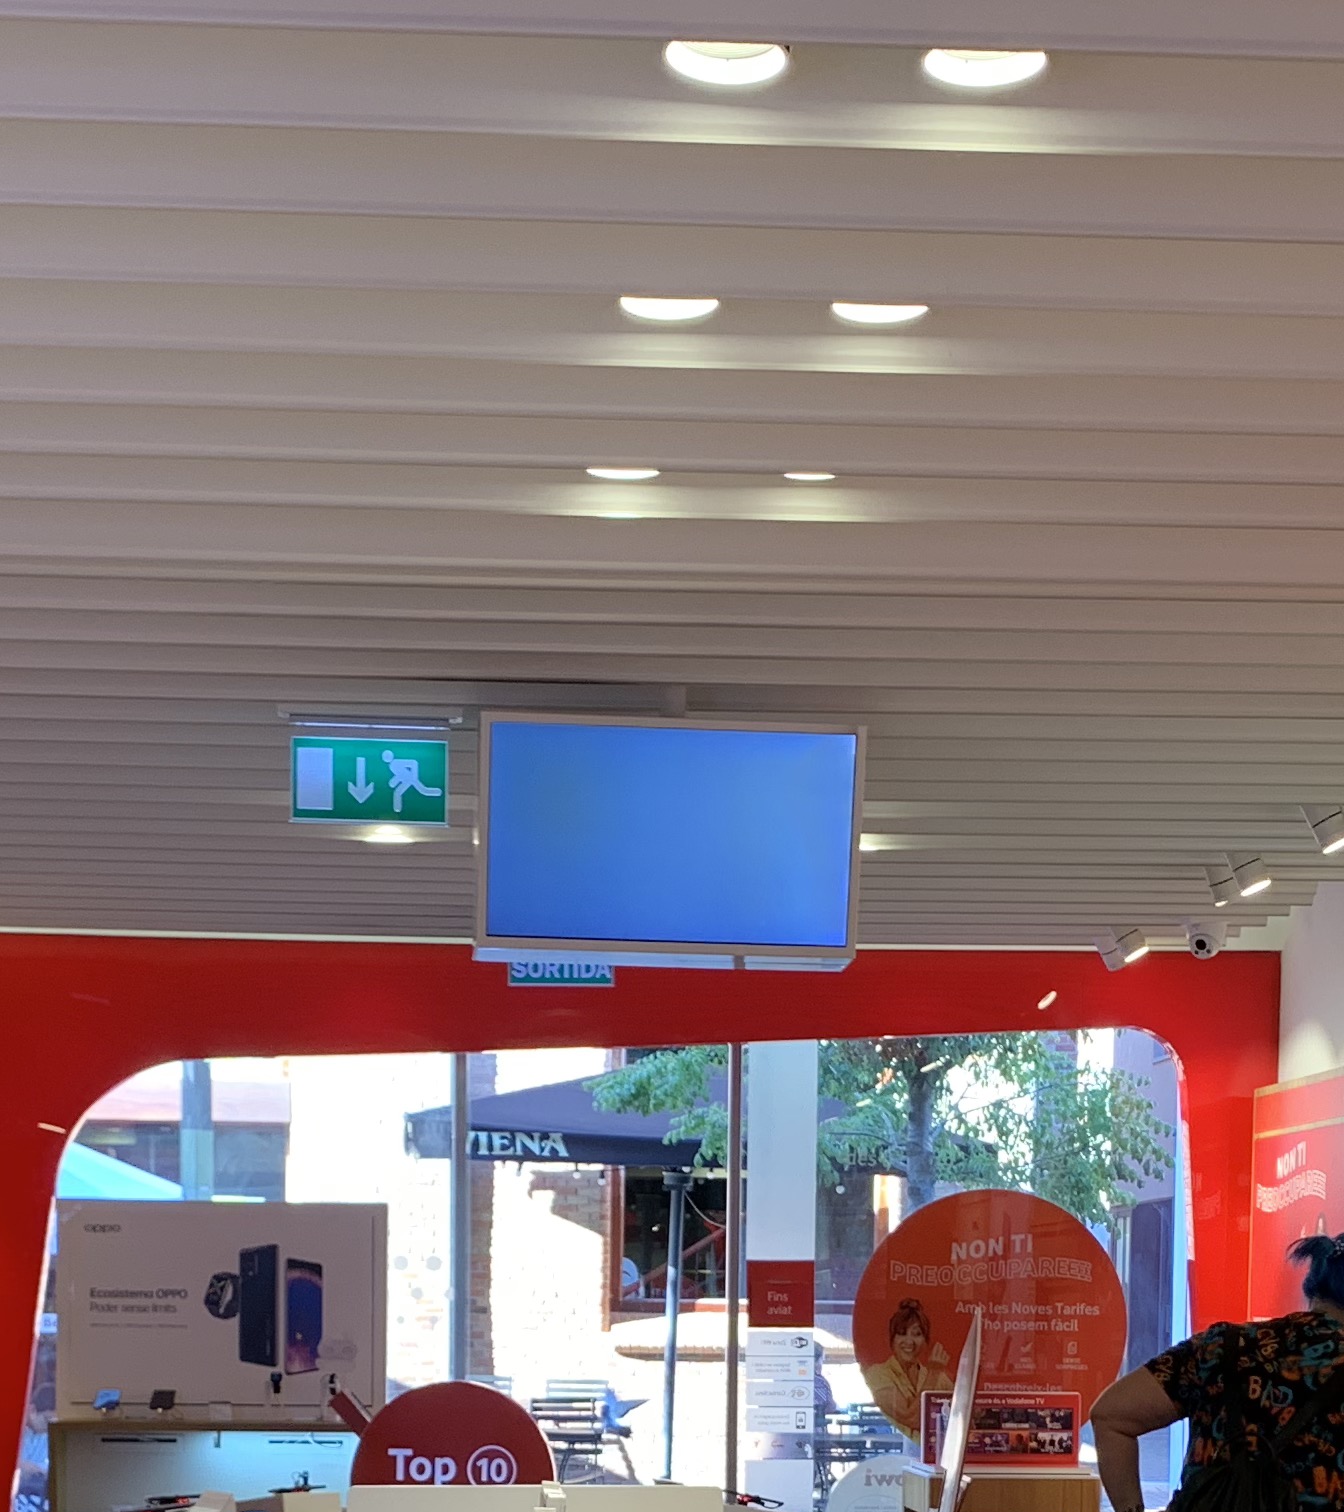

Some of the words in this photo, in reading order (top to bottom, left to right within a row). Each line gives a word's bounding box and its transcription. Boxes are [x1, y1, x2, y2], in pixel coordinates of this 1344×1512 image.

[511, 961, 612, 979] SORTIDA
[1276, 1147, 1296, 1180] NON
[1297, 1141, 1306, 1167] TI
[951, 1237, 1003, 1262] NON
[1011, 1233, 1033, 1254] TI
[156, 1288, 188, 1299] OPPO
[767, 1291, 789, 1302] Fins
[767, 1305, 793, 1316] aviat
[989, 1302, 1009, 1315] les
[1012, 1303, 1053, 1315] Noves
[1055, 1302, 1101, 1316] Tarifes
[1003, 1321, 1048, 1333] posem
[1050, 1318, 1079, 1332] fàcil
[387, 1448, 457, 1485] Top
[476, 1457, 508, 1483] 10
